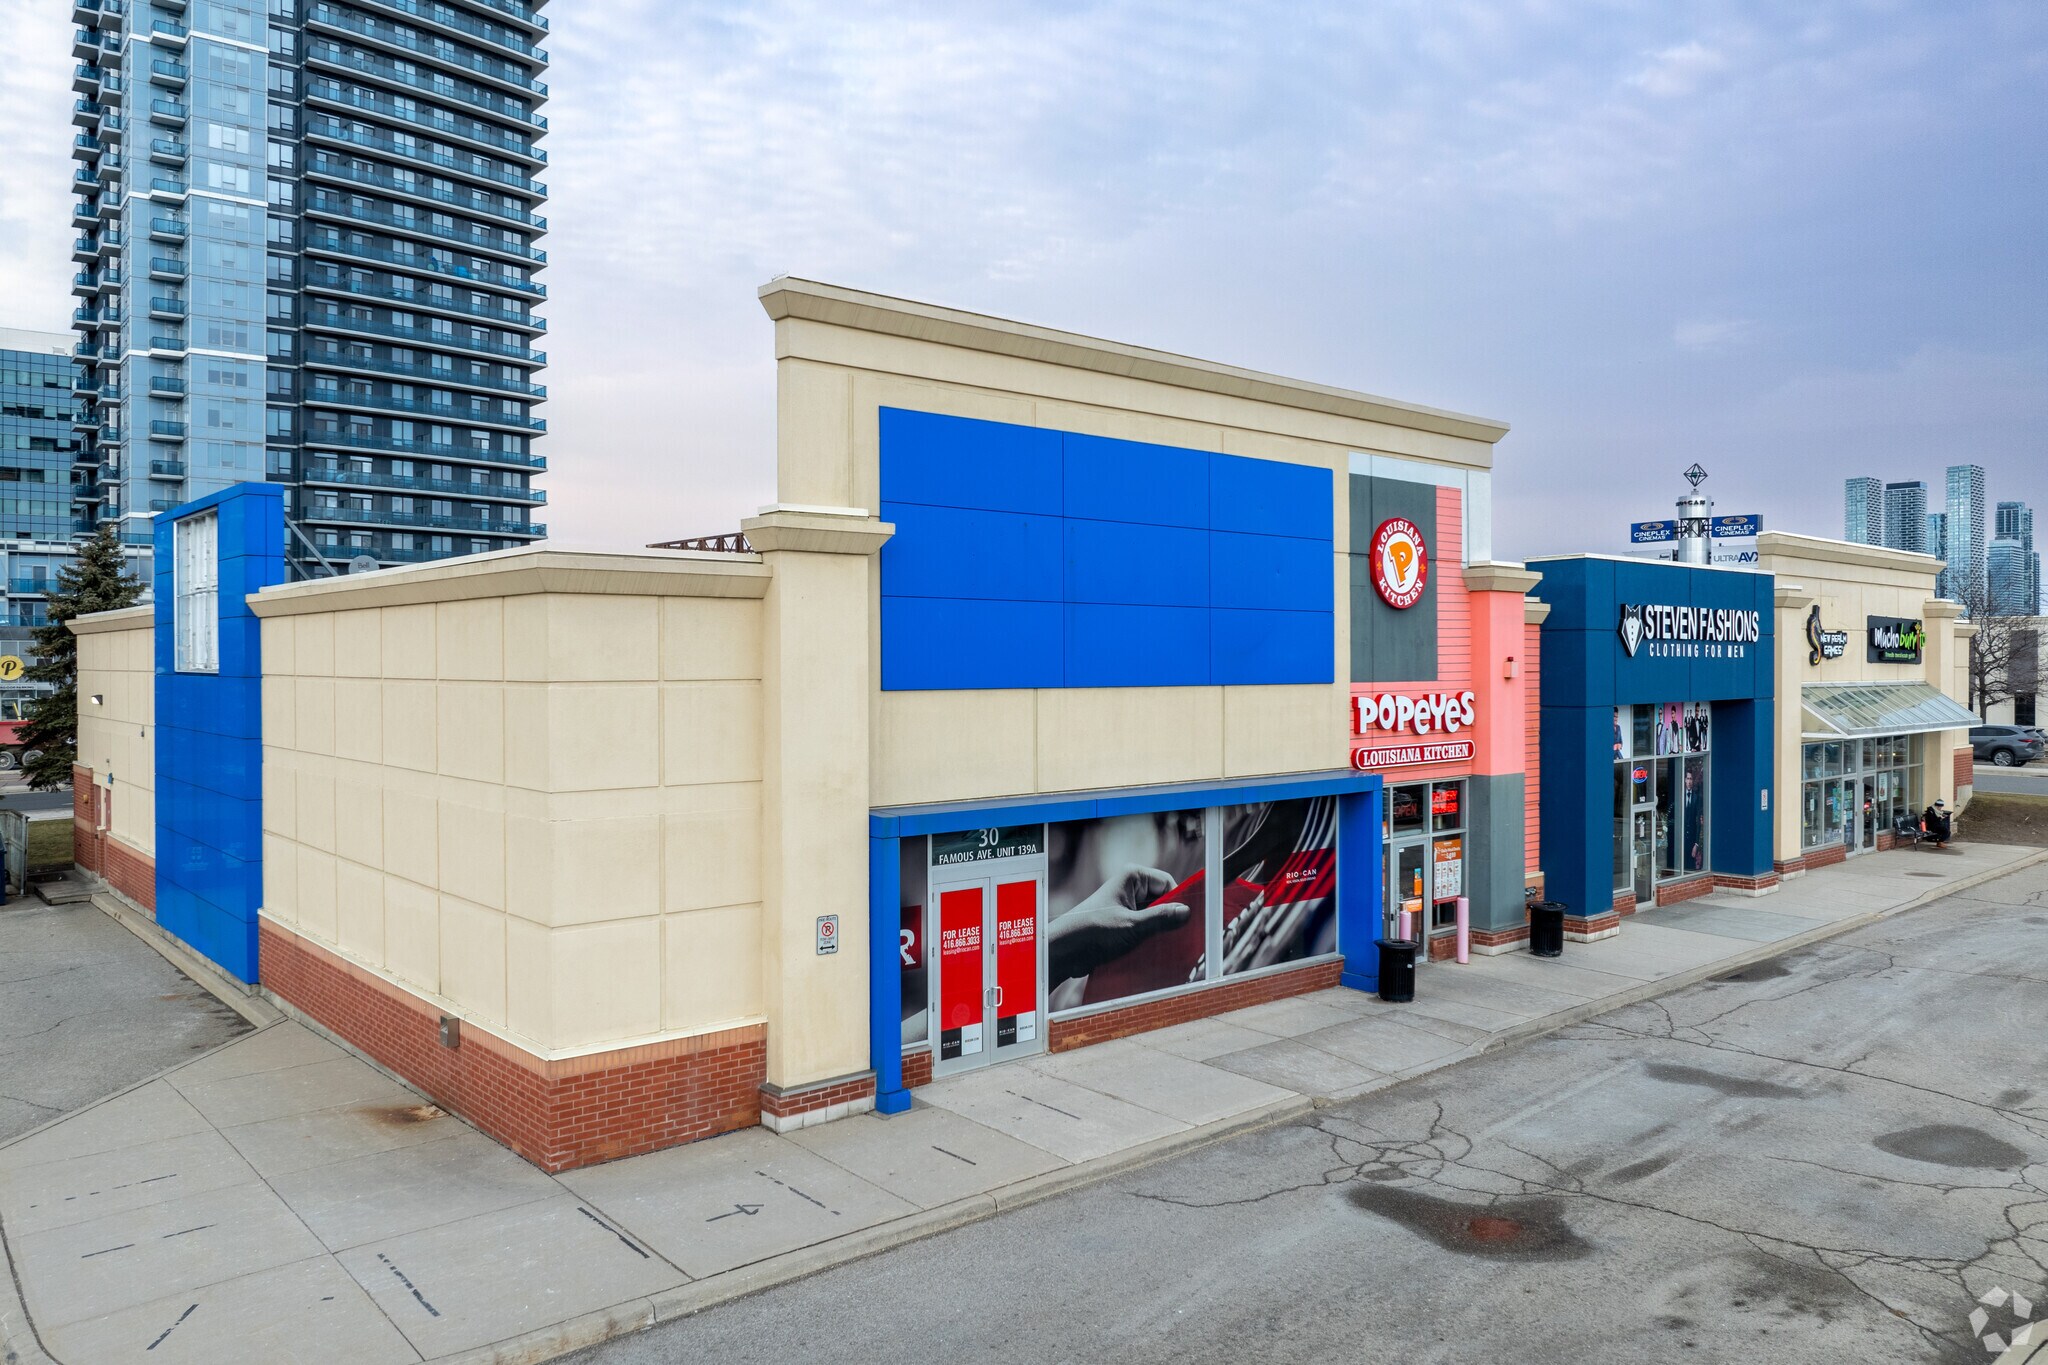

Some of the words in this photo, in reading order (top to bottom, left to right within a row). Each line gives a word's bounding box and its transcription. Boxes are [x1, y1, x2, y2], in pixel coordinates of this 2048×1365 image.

[1634, 529, 1671, 538] CINEPLEX
[1714, 524, 1755, 532] CINEPLEX
[1377, 520, 1424, 556] LOUISIANA
[1379, 577, 1424, 606] KITCHEN
[1644, 604, 1697, 640] STEVEN
[1699, 607, 1759, 642] FASHIONS
[1649, 643, 1699, 658] CLOTHING
[1705, 644, 1722, 658] FOR
[1727, 645, 1744, 658] MEN
[1823, 645, 1844, 657] GAMES
[1363, 747, 1421, 766] LOUISIANA
[1423, 743, 1469, 761] KITCHEN
[978, 828, 999, 847] 30
[939, 850, 974, 865] FAMOUS
[976, 848, 995, 860] AVE.
[996, 846, 1015, 858] UNIT
[1018, 844, 1037, 855] 139A
[1286, 871, 1299, 879] RIO
[999, 920, 1012, 931] FOR
[1013, 917, 1034, 929] LEASE
[943, 929, 956, 940] FOR
[958, 926, 980, 938] LEASE
